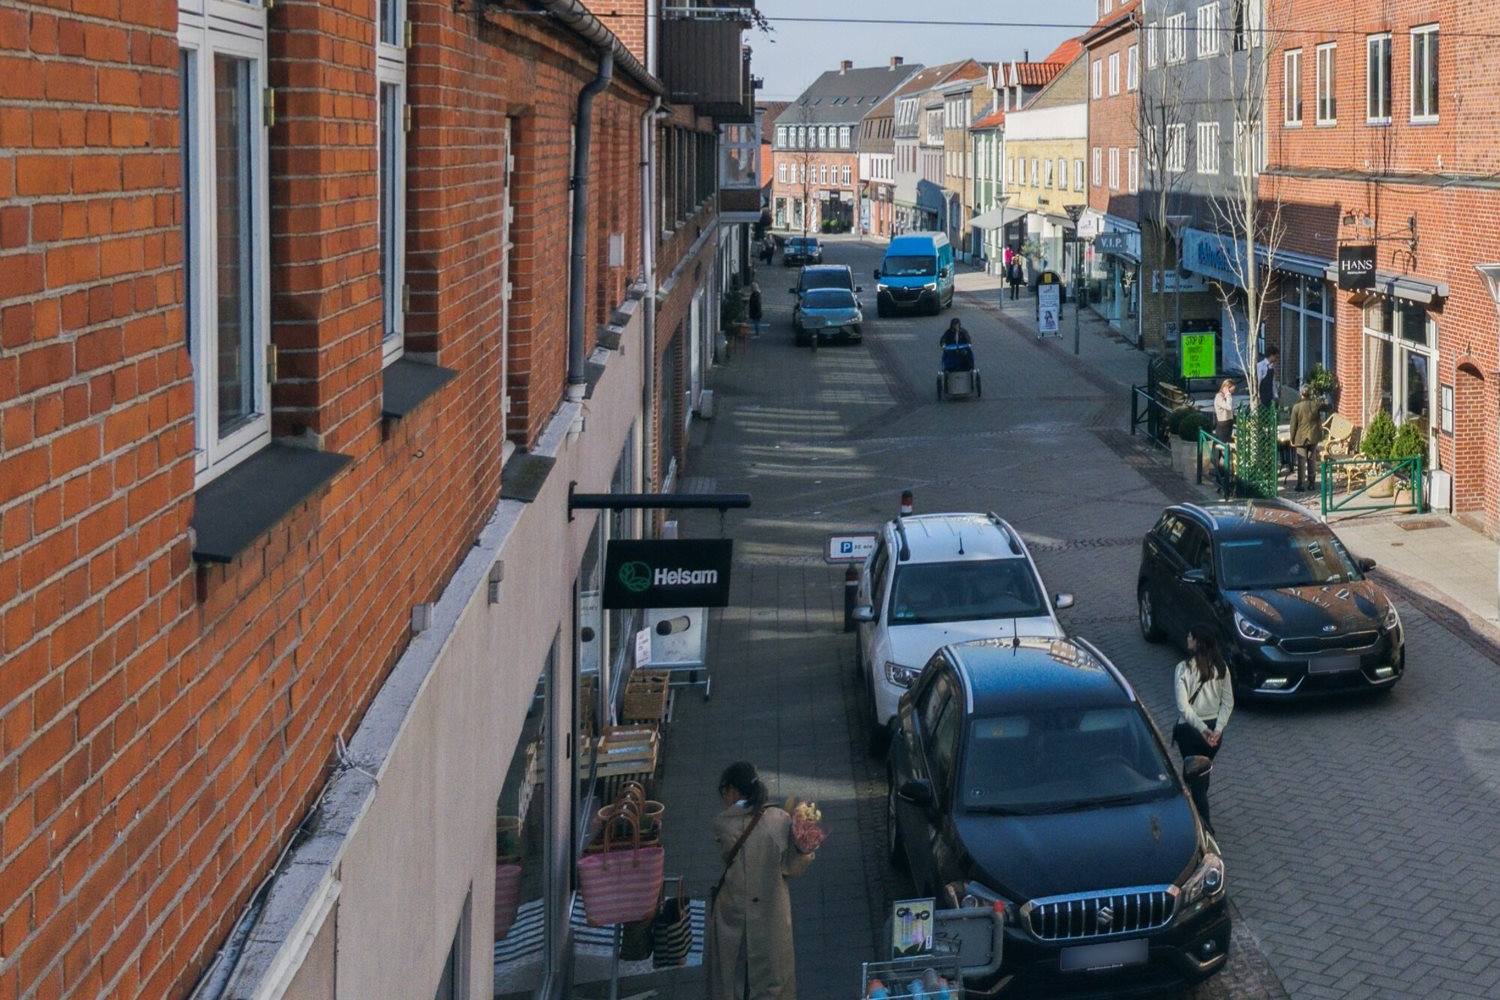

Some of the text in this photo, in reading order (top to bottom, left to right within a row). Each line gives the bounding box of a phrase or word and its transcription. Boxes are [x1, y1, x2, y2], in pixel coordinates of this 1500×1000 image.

[1101, 237, 1123, 248] V.I.P.
[1341, 260, 1373, 271] HANS
[653, 567, 718, 586] Helsam
